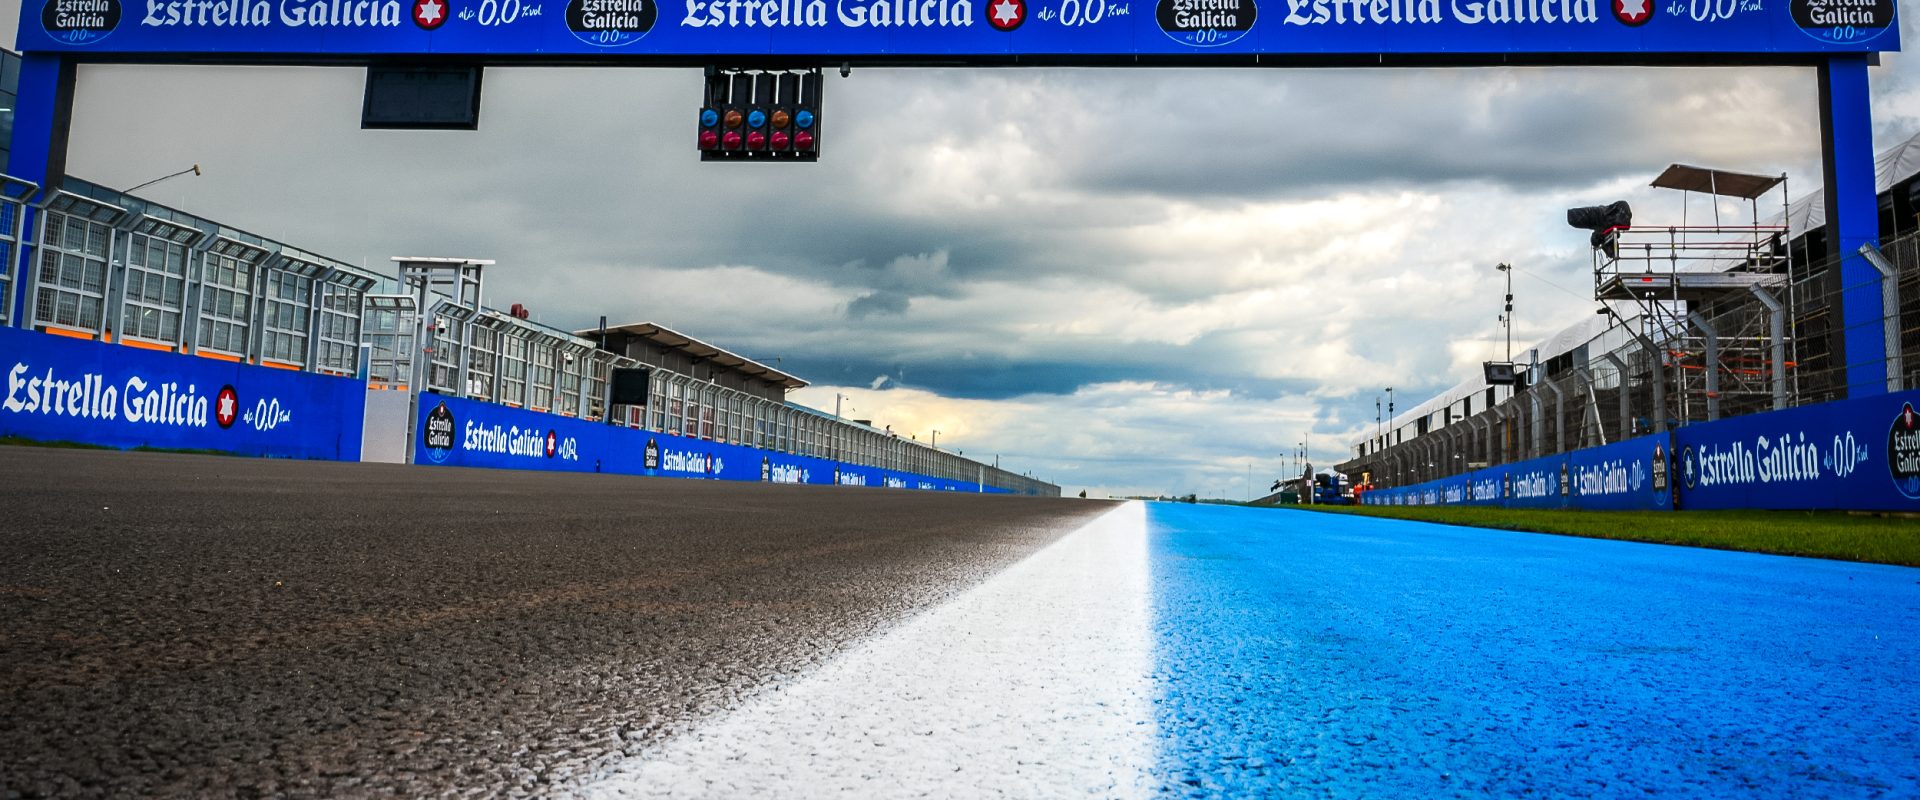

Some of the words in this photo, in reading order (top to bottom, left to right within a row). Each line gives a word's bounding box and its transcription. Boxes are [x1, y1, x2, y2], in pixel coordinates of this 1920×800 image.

[55, 0, 109, 12] Estrella
[141, 0, 271, 27] Estrella
[280, 0, 402, 27] Galicia
[581, 0, 643, 12] Estrella
[681, 0, 828, 28] Estrella
[837, 0, 974, 28] Galicia
[1283, 0, 1443, 26] Estrella
[1452, 0, 1599, 24] Galicia
[55, 13, 104, 28] Galicia
[582, 12, 639, 29] Galicia
[1175, 11, 1237, 28] Galicia
[1810, 7, 1874, 24] Galicia
[2, 362, 117, 420] Estrella
[123, 376, 208, 427] Galicia
[255, 398, 279, 431] 0,0
[429, 416, 451, 432] Estrella
[429, 431, 450, 447] Galicia
[463, 419, 507, 454] Estrella
[508, 425, 543, 458] Galicia
[1699, 441, 1756, 486] Estrella
[1757, 431, 1820, 483] Galicia
[1834, 431, 1855, 478] 0,0
[1580, 464, 1602, 496] Estrella
[1603, 459, 1627, 495] Galicia
